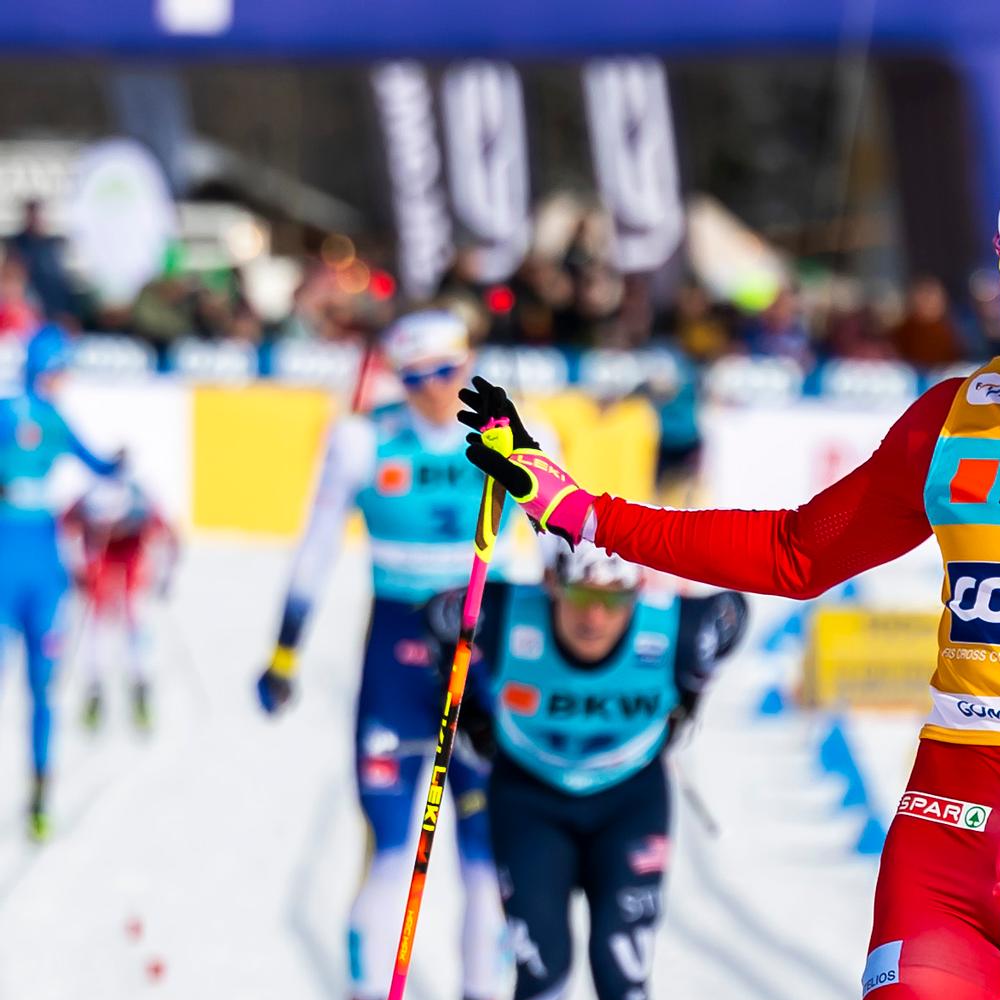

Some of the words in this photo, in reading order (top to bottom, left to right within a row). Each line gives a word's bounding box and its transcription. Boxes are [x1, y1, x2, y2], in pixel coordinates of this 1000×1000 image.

[516, 454, 566, 482] LEKI
[548, 691, 661, 719] BKW
[423, 765, 447, 832] LEKI
[898, 796, 961, 822] SPAR
